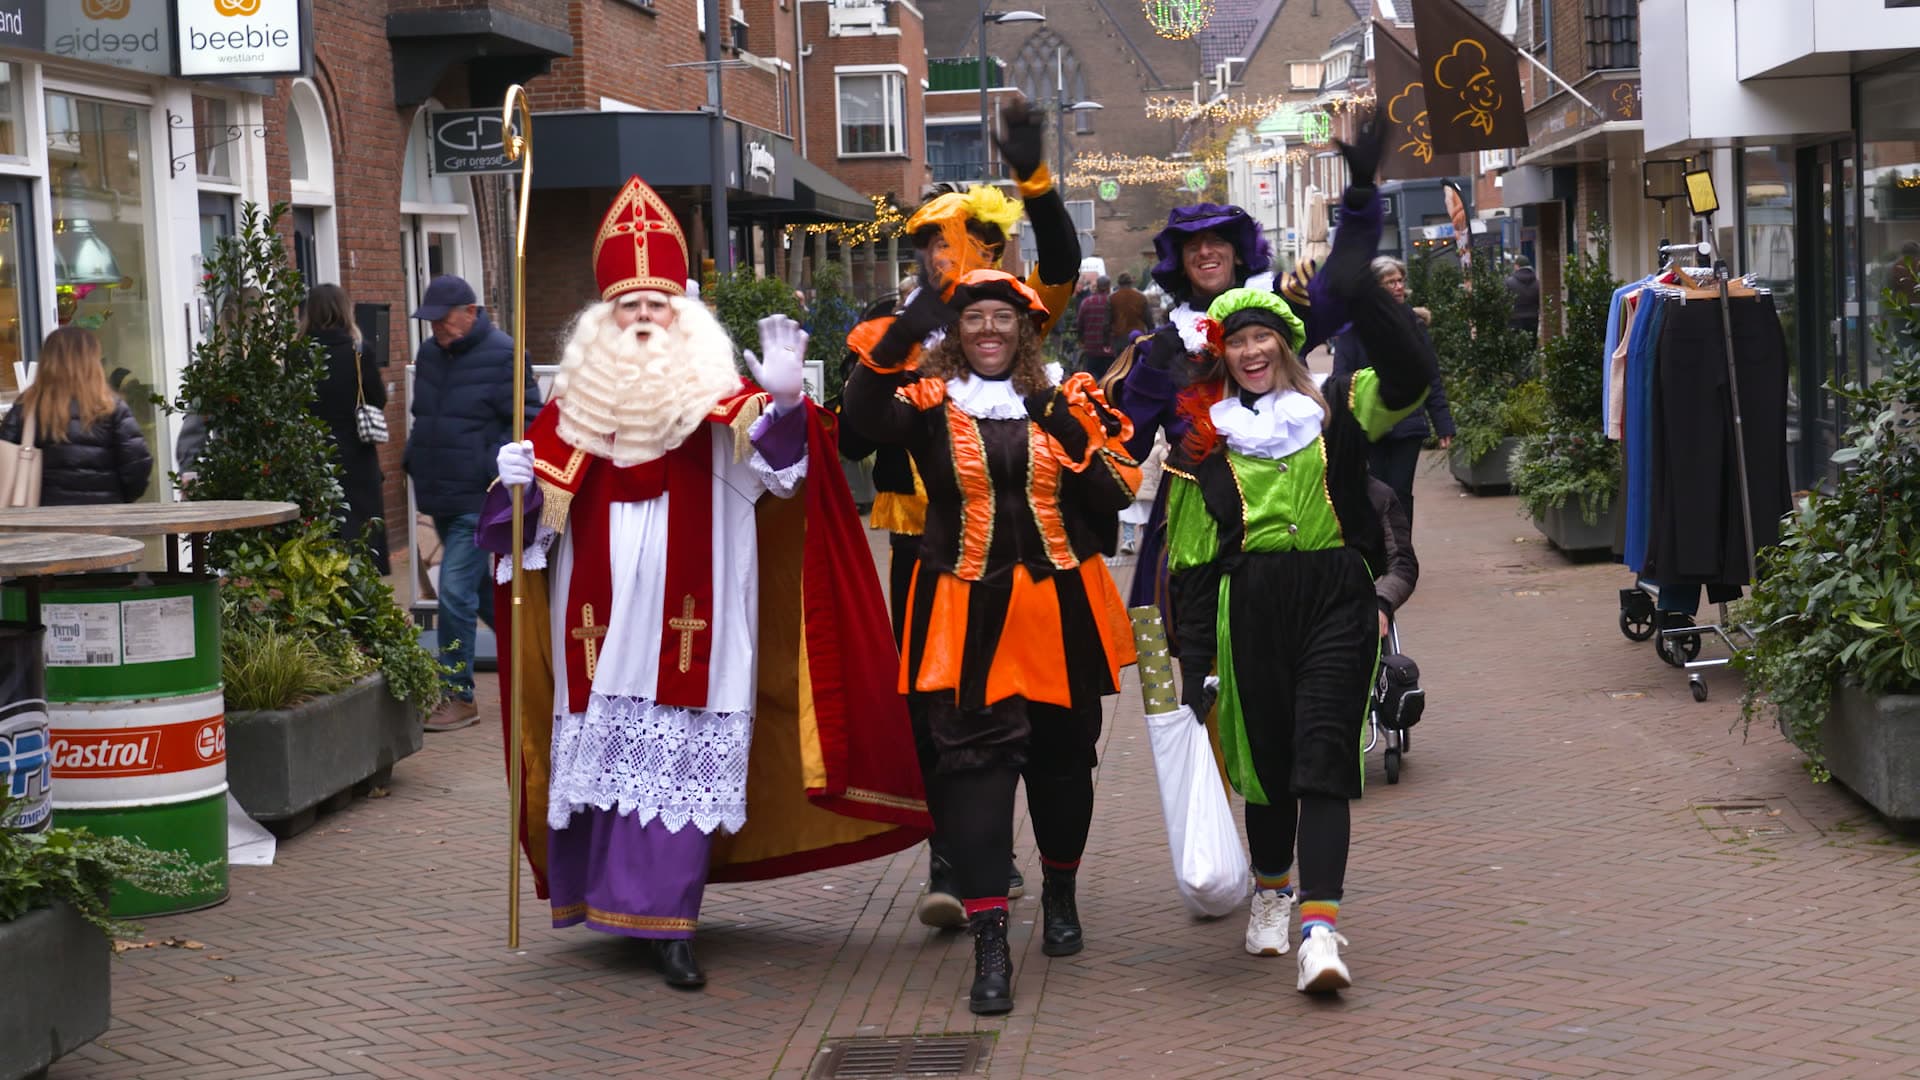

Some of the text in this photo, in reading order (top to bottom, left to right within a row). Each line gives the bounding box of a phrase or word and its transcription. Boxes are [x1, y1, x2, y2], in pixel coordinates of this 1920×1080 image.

[190, 23, 289, 50] beebie
[217, 52, 265, 63] westland
[51, 736, 149, 769] Castrol
